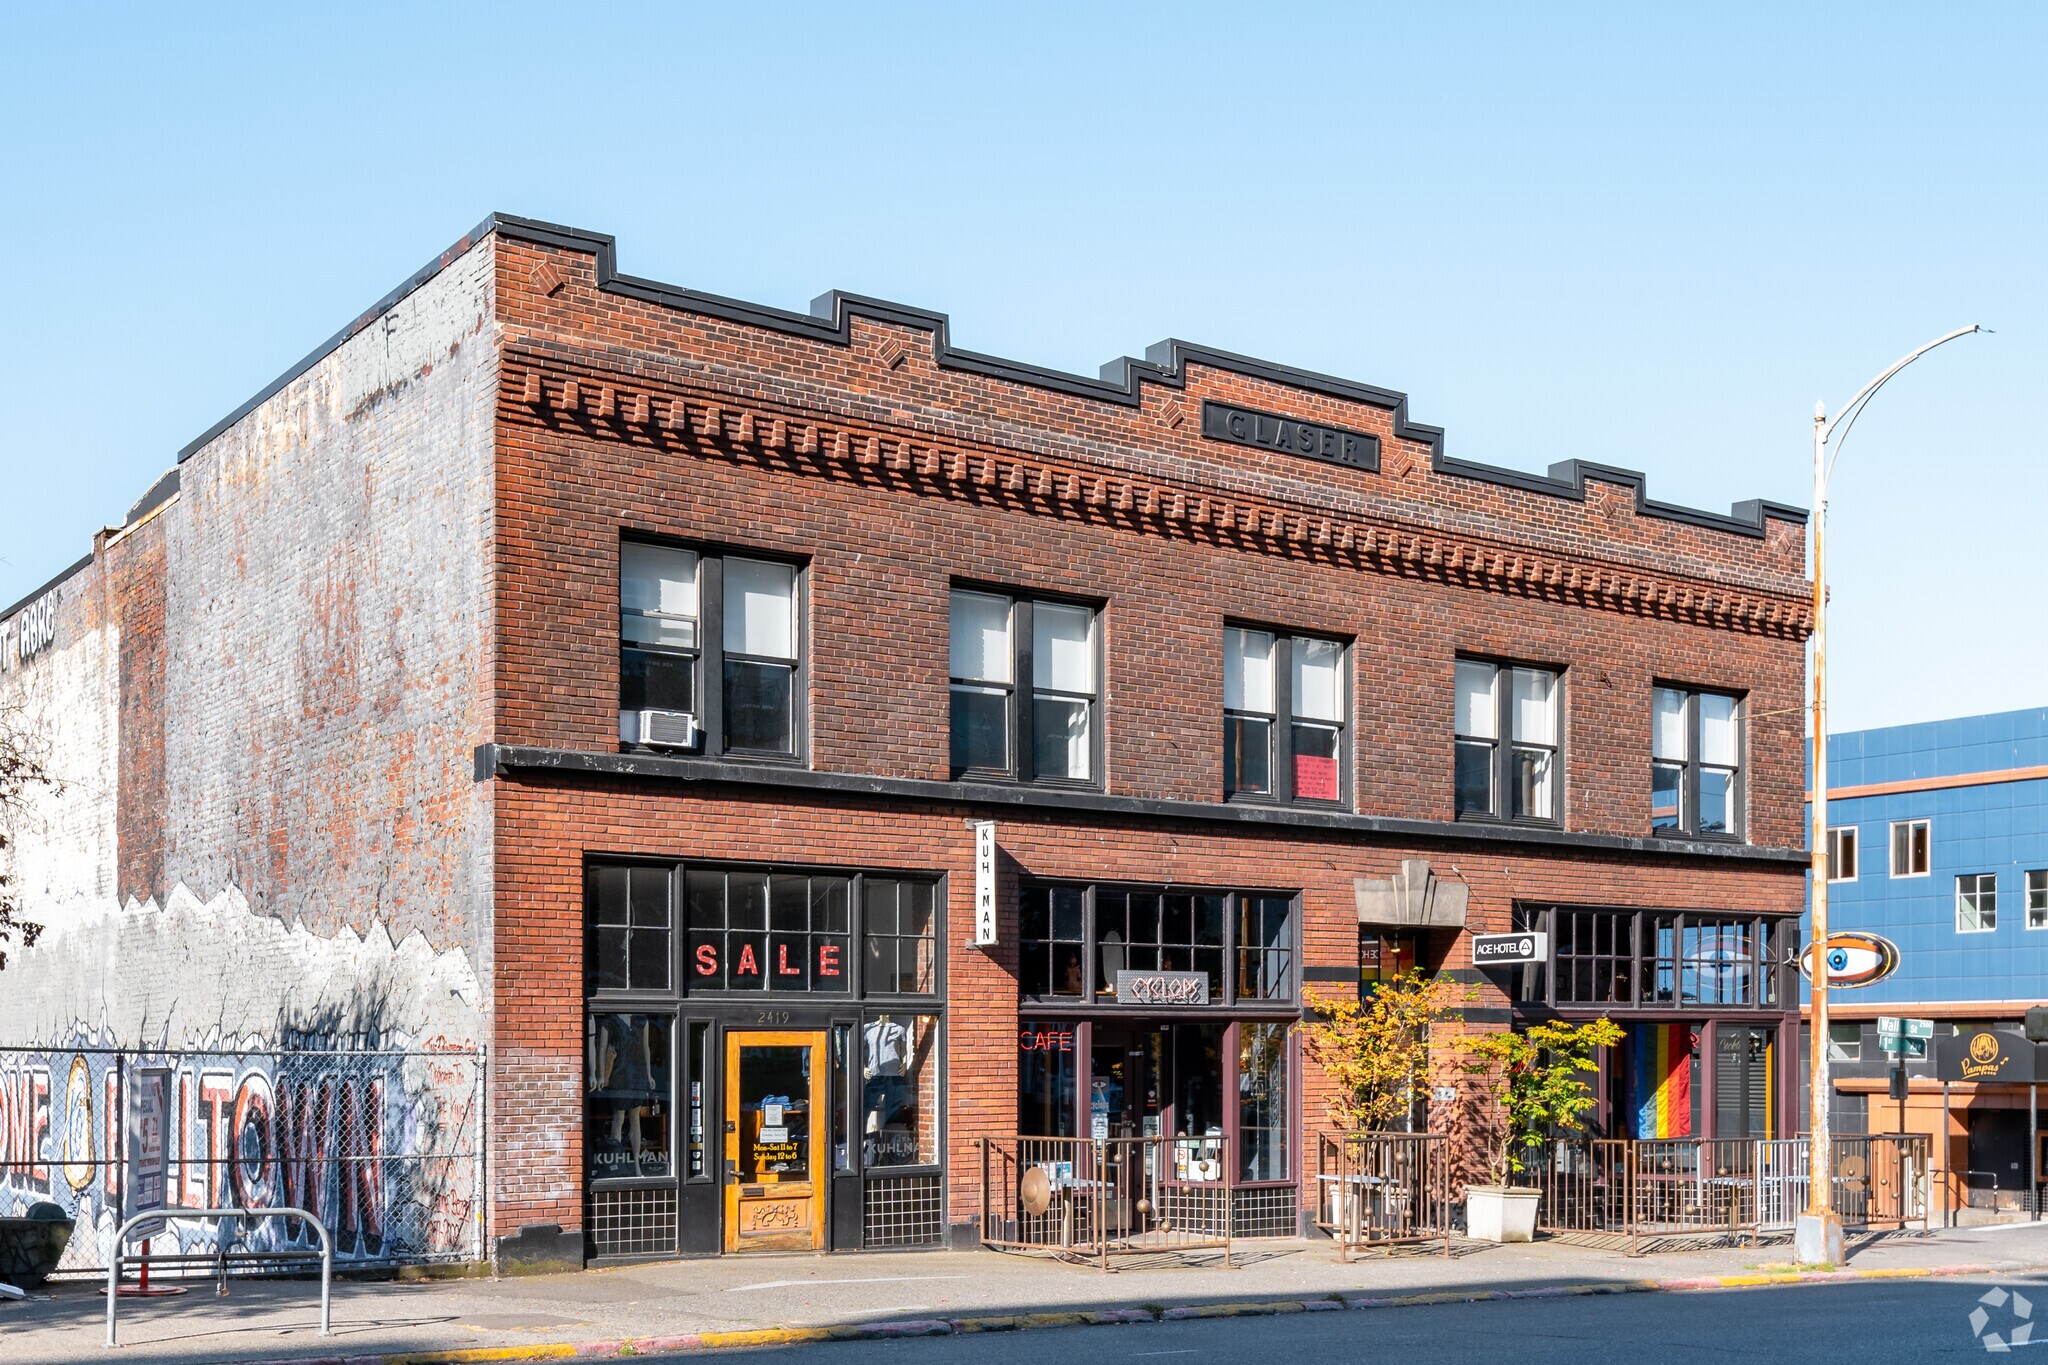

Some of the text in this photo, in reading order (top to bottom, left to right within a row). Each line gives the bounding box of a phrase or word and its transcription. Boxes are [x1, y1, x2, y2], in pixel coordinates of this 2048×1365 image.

[982, 828, 990, 940] KUHMAN
[1476, 944, 1493, 955] ACE
[1493, 942, 1519, 954] HOTEL
[695, 943, 841, 976] SALE
[757, 1011, 790, 1024] 2419
[1909, 1024, 1918, 1034] St
[1020, 1031, 1071, 1051] CAFE
[1883, 1036, 1921, 1051] 1st Ave
[1960, 1057, 1999, 1076] Pampas
[753, 1143, 780, 1151] Mon-Sat
[868, 1142, 931, 1154] KUHLMA
[593, 1150, 669, 1165] KUHLMAN
[753, 1152, 777, 1161] Sunday
[777, 1152, 785, 1160] 12
[785, 1152, 792, 1160] to
